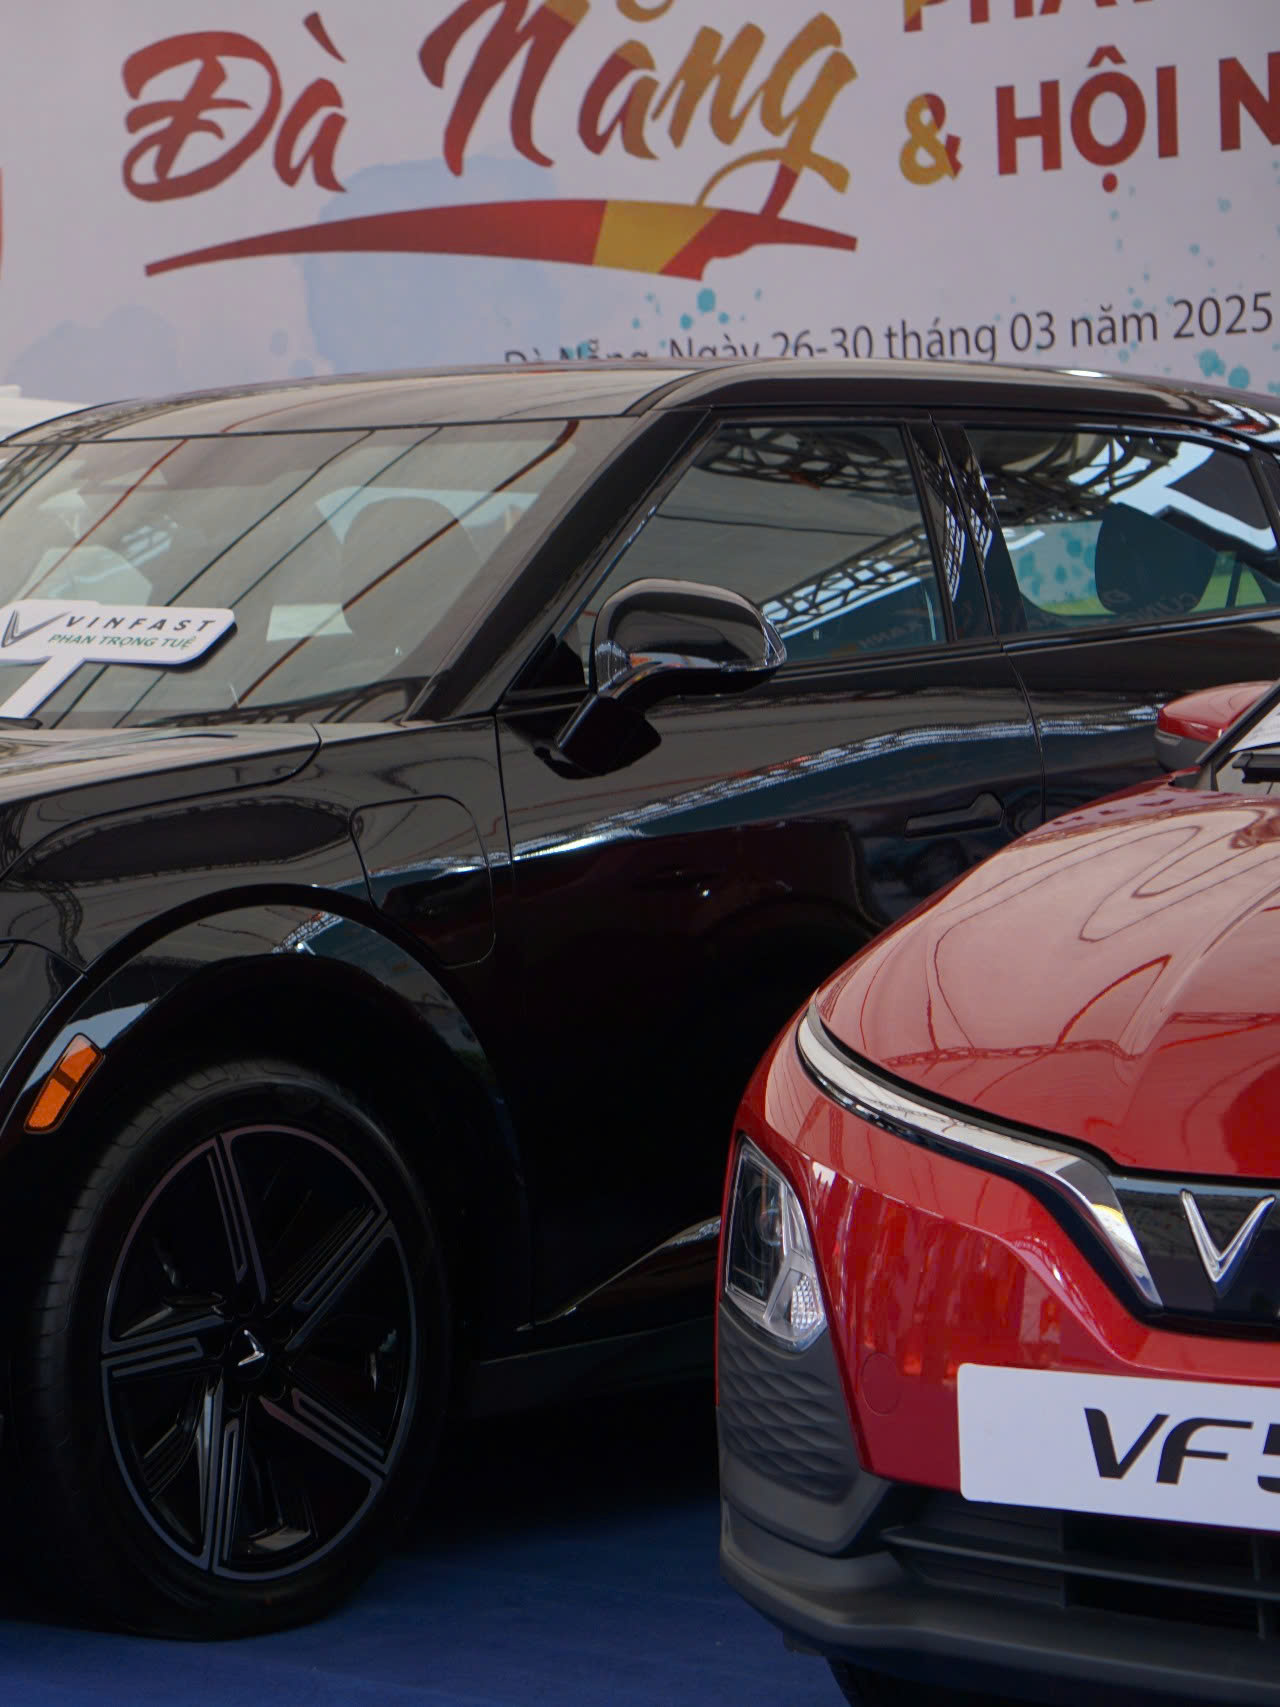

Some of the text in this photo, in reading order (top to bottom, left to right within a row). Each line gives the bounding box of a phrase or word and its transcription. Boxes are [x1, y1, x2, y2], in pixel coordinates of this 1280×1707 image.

[123, 12, 347, 202] Đà
[899, 93, 962, 185] &
[995, 45, 1178, 193] HỘI
[772, 325, 873, 358] 26-30
[885, 317, 996, 362] tháng
[1010, 310, 1055, 351] 03
[1071, 304, 1157, 347] năm
[1173, 292, 1273, 340] 2025
[48, 633, 95, 645] PHAN
[65, 616, 216, 632] VINFAST
